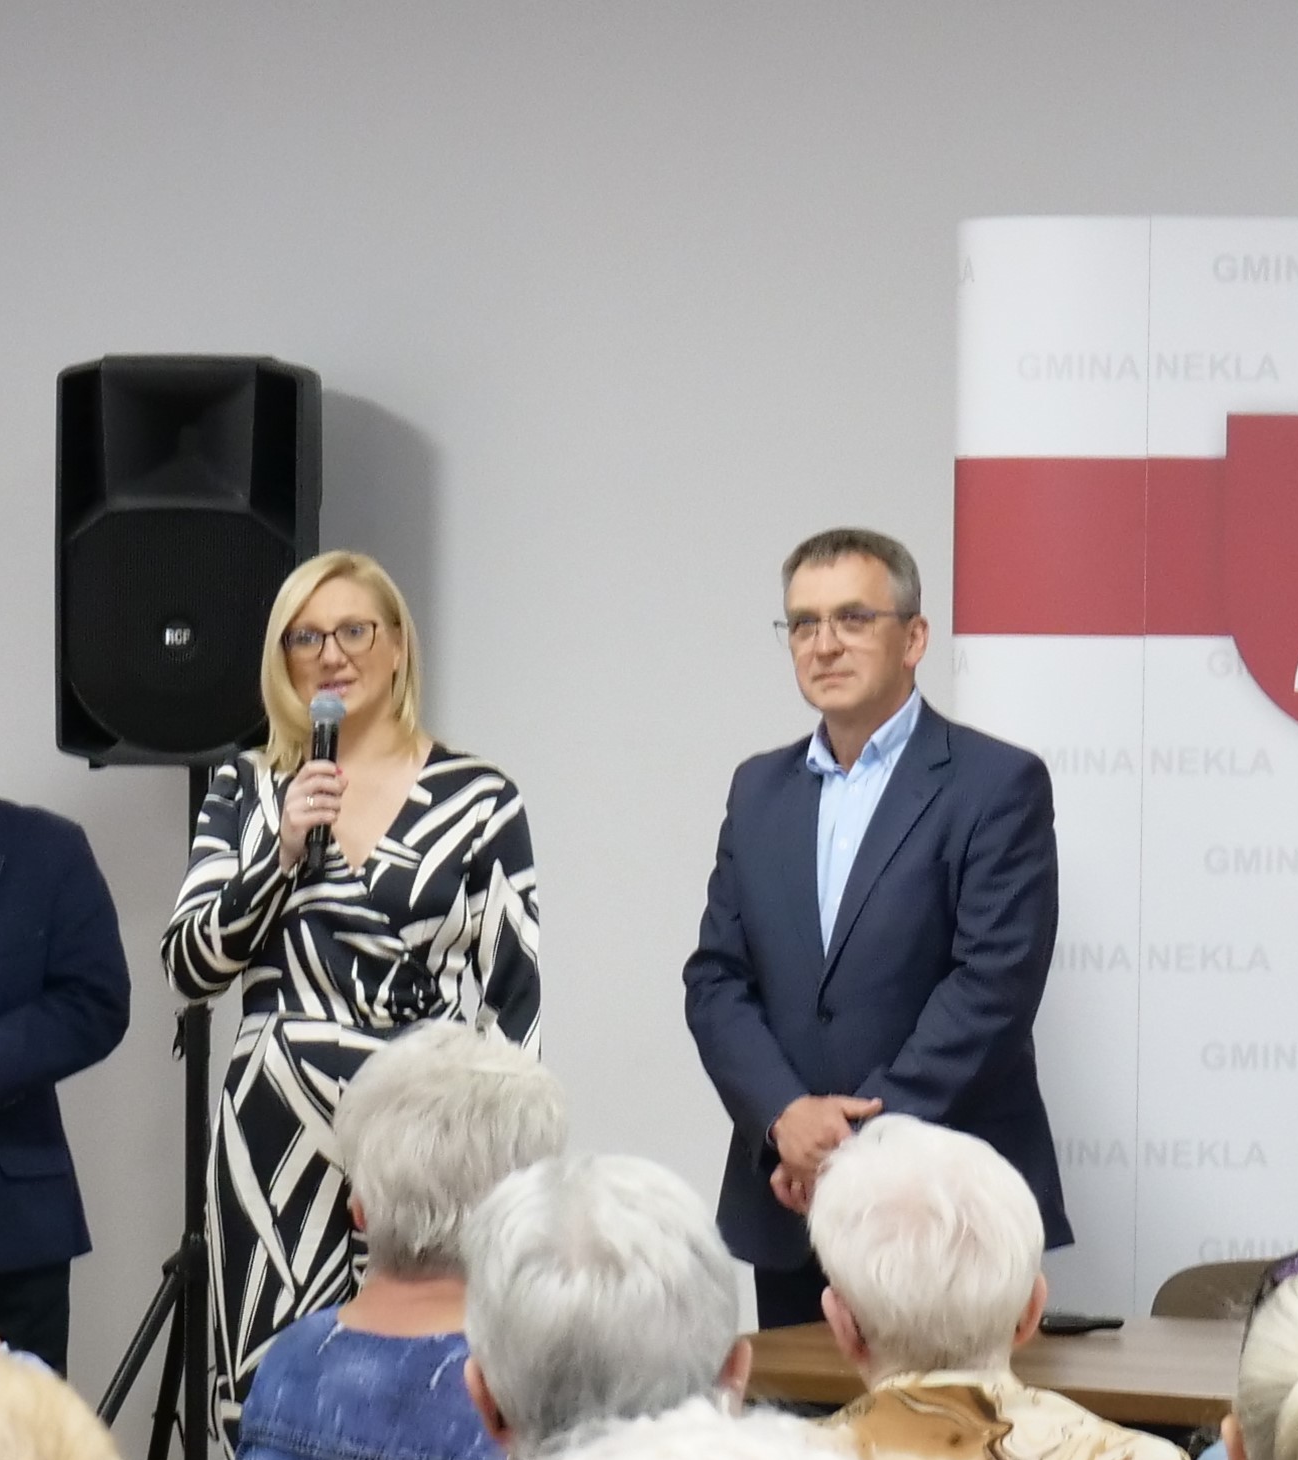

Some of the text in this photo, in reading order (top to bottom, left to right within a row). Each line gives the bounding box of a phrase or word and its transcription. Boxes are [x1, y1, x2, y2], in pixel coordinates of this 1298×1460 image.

[1017, 353, 1280, 382] GMINA NEKLA
[1046, 748, 1273, 775] MINA NEKLA
[1147, 944, 1270, 973] NEKLA
[1144, 1141, 1267, 1170] NEKLA
